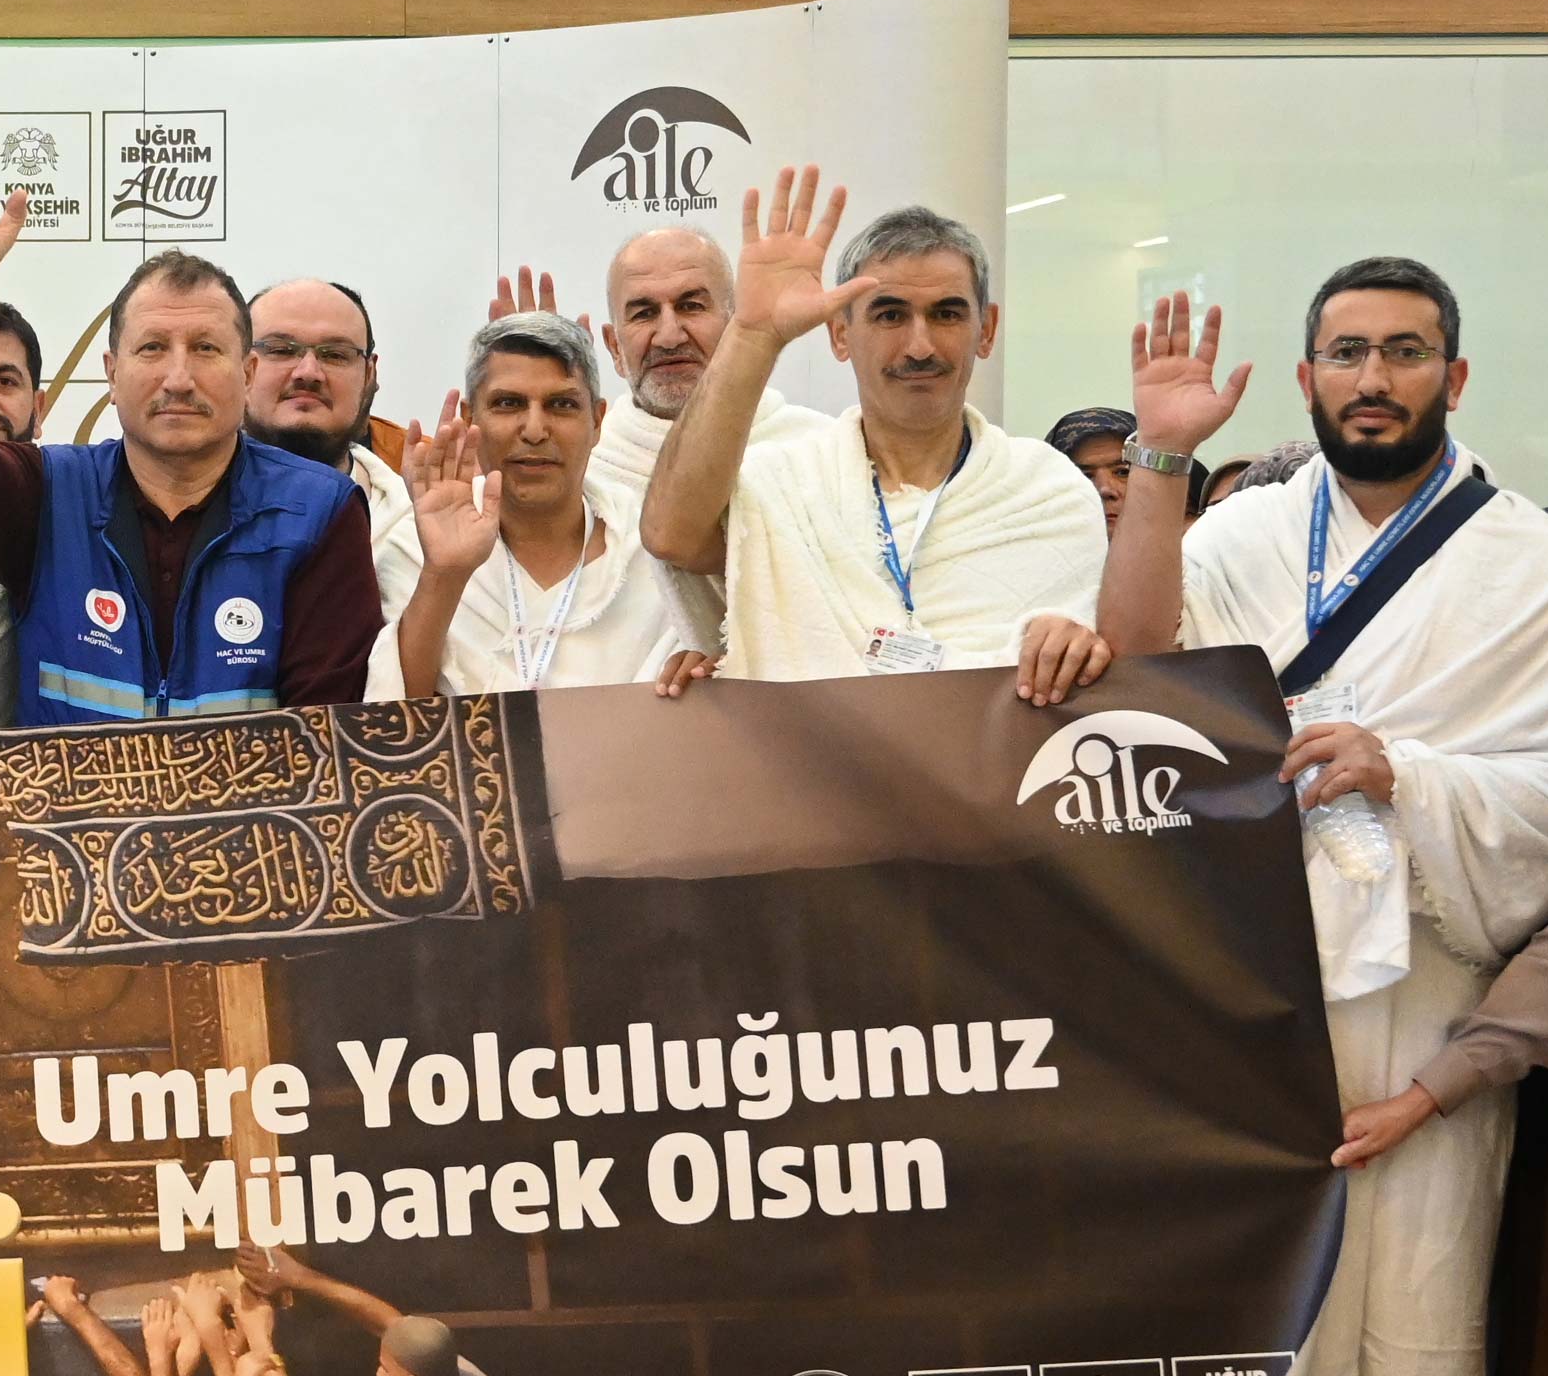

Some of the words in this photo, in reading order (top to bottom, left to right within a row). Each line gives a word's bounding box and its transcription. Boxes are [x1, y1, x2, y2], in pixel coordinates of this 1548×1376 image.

[135, 124, 196, 146] UĞUR
[603, 115, 714, 202] aile
[111, 165, 218, 221] Altay
[644, 199, 660, 212] ve
[665, 196, 717, 217] toplum
[216, 649, 233, 657] HAC
[244, 648, 266, 656] UMRE
[1054, 739, 1184, 825] aile
[1102, 820, 1123, 833] ve
[1127, 813, 1192, 836] toplum
[33, 1055, 309, 1147] Umre
[336, 1011, 1060, 1129] Yolculuğunuz
[154, 1138, 621, 1253] Mübarek
[646, 1130, 948, 1225] Olsun
